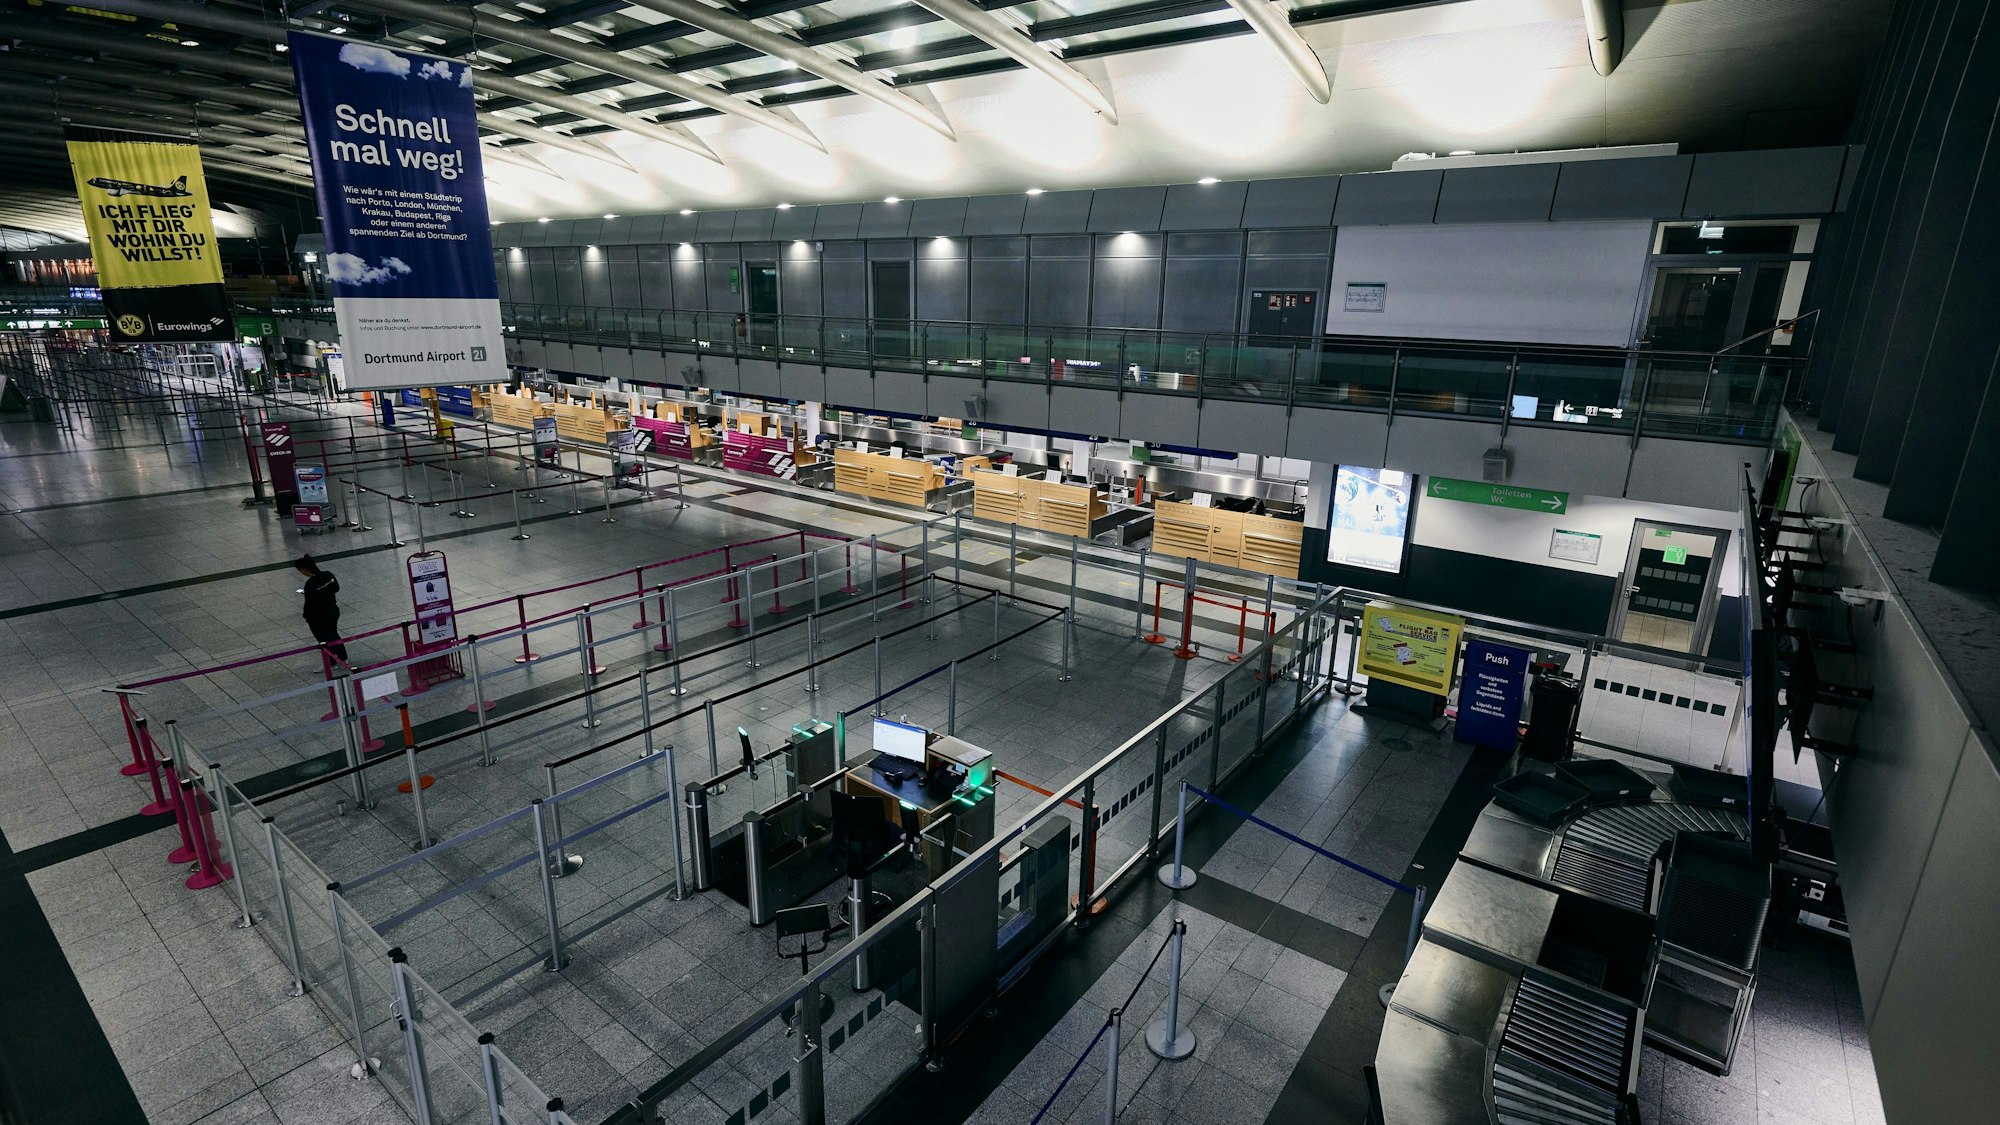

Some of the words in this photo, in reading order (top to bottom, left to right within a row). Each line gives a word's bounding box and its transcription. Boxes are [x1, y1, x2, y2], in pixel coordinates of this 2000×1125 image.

[335, 104, 451, 143] Schnell
[330, 140, 390, 166] mal
[396, 148, 463, 180] weg!
[343, 185, 359, 194] Wie
[385, 189, 398, 197] mit
[400, 191, 423, 199] einem
[424, 192, 462, 203] Städtetrip
[346, 196, 366, 205] nach
[368, 198, 393, 208] Porto,
[394, 199, 425, 210] London,
[427, 202, 463, 213] München,
[98, 205, 132, 219] ICH
[362, 208, 393, 218] Krakau,
[395, 210, 434, 220] Budapest,
[436, 213, 451, 222] Riga
[113, 220, 147, 233] MIT
[153, 219, 186, 233] DIR
[370, 219, 389, 227] oder
[391, 220, 414, 228] einem
[416, 221, 447, 230] anderen
[349, 228, 398, 237] spannenden
[400, 230, 414, 238] Ziel
[416, 231, 426, 239] ab
[428, 232, 468, 240] Dortmund?
[106, 234, 177, 248] WOHIN
[180, 234, 206, 246] DU
[120, 248, 202, 262] WILLST!
[120, 314, 142, 330] BVB
[157, 322, 212, 333] Eurowings
[261, 322, 273, 335] B
[364, 352, 424, 364] Dortmund
[427, 350, 466, 363] Airport
[472, 350, 484, 360] 21
[1490, 495, 1504, 504] WC
[1492, 488, 1532, 498] Toiletten
[1399, 623, 1422, 632] FLIGHT
[1424, 628, 1438, 636] BAG
[1410, 630, 1437, 640] SERVICE
[1486, 652, 1509, 666] Push
[1478, 672, 1508, 684] Flüssigkeiten
[1476, 690, 1505, 700] Gegenstände
[1470, 705, 1492, 715] forbidden
[1476, 701, 1492, 710] Liquids
